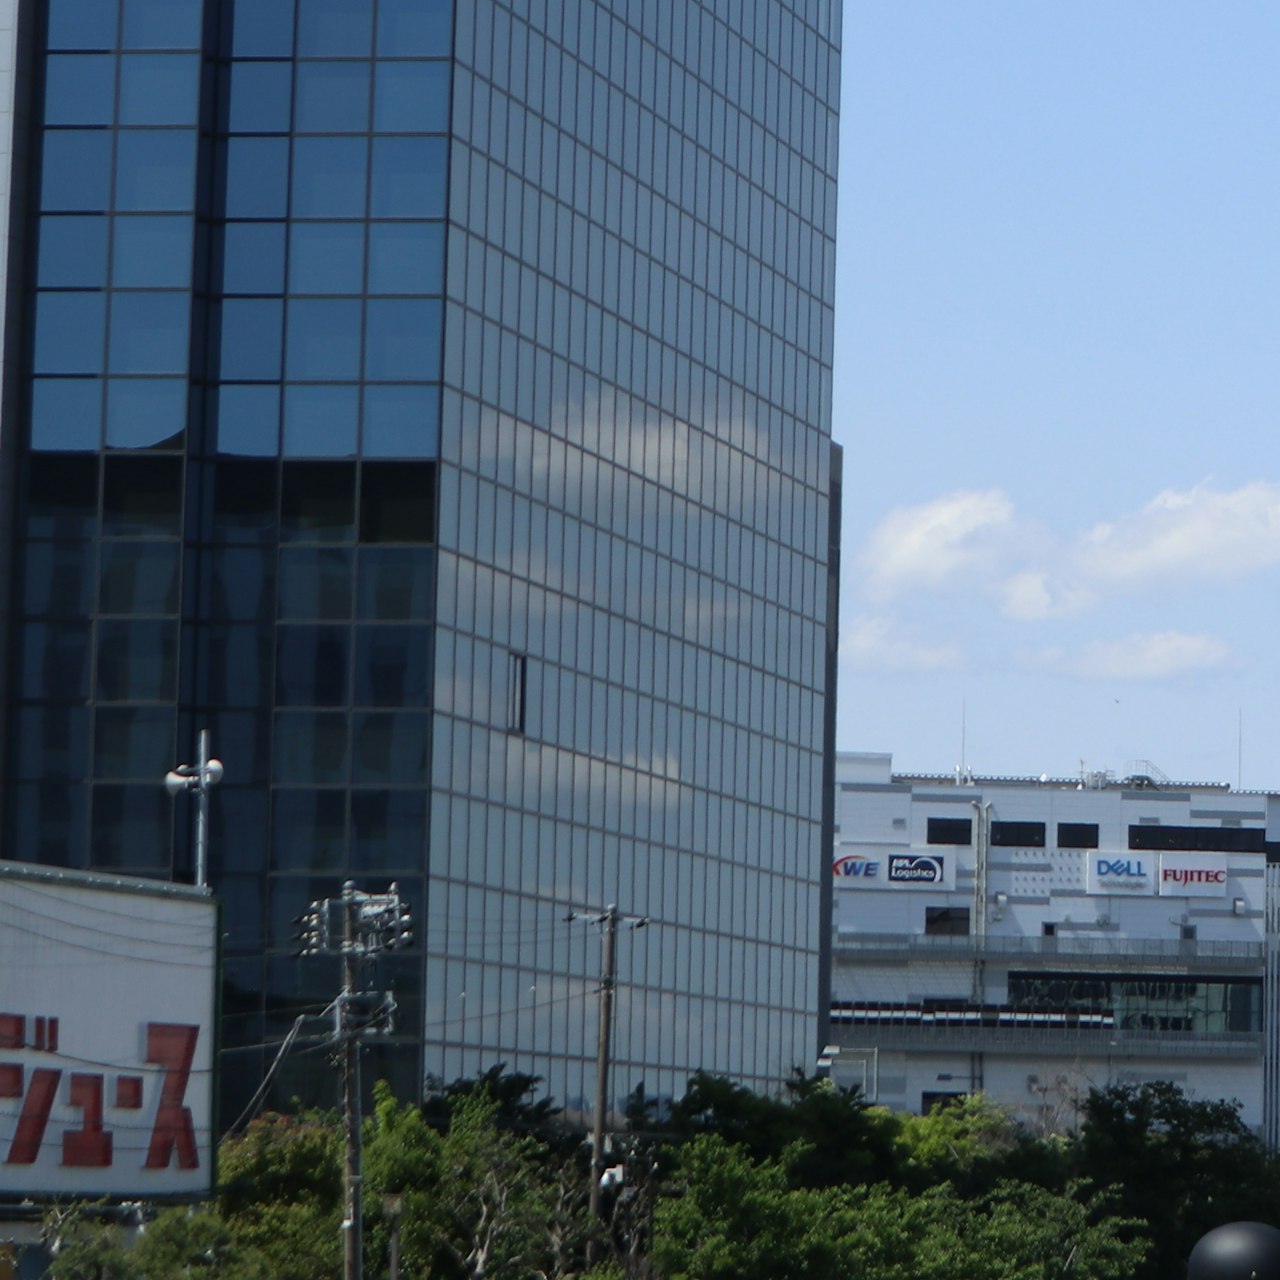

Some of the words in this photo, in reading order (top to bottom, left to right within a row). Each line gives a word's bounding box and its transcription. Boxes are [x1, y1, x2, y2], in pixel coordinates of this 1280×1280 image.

[891, 867, 935, 879] Logistics
[1097, 859, 1147, 877] DELL
[1163, 869, 1226, 886] FUJITEC
